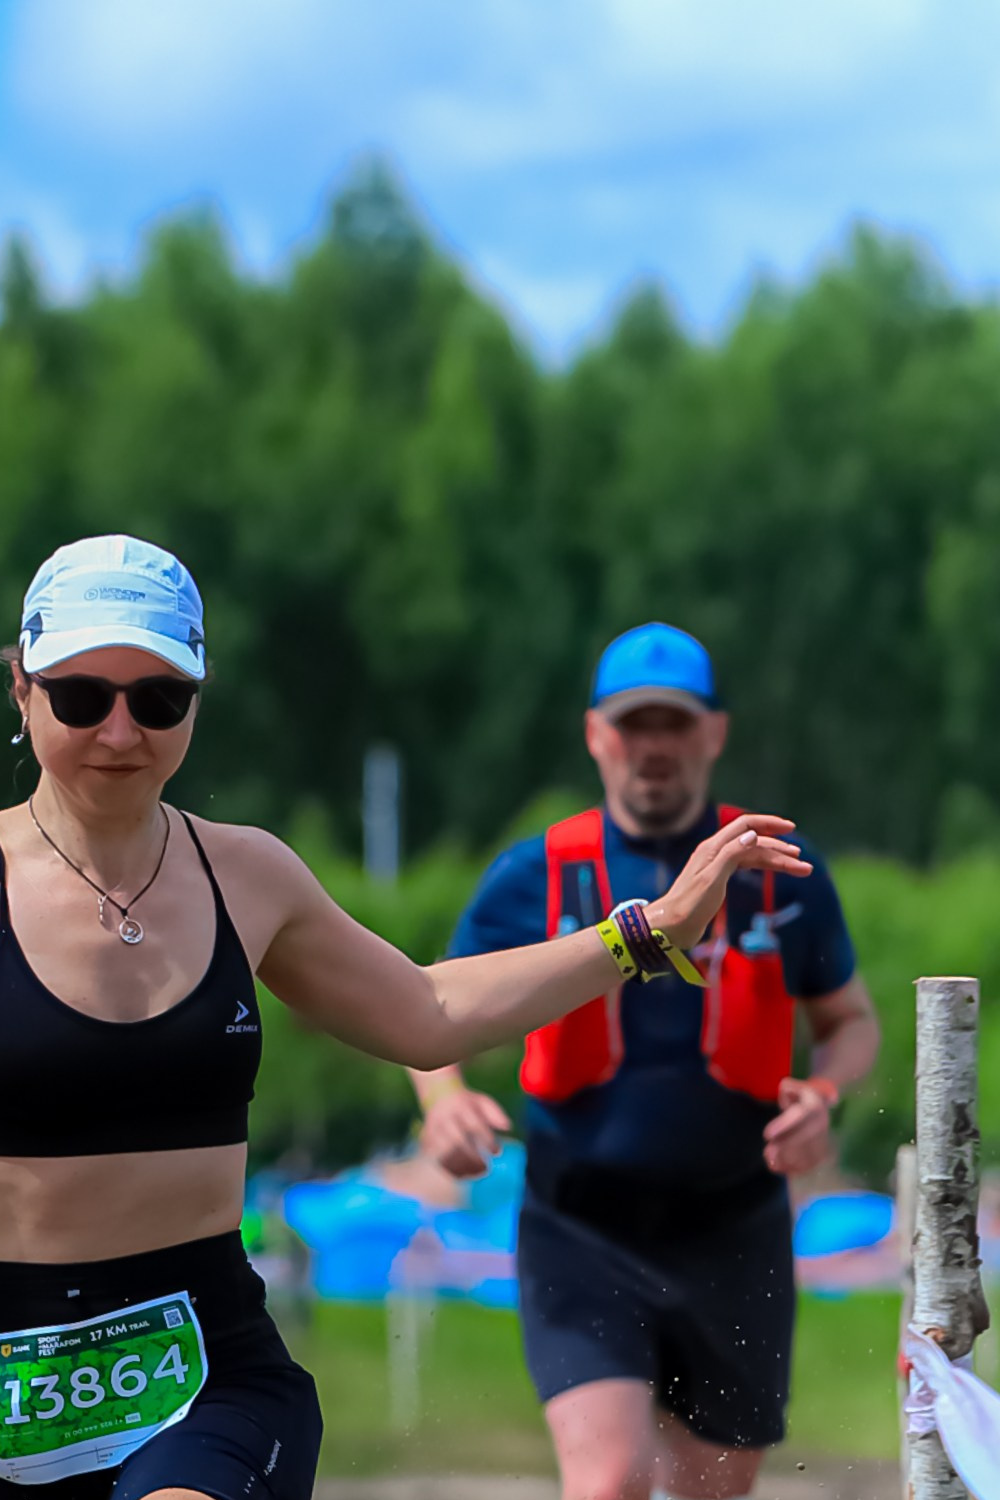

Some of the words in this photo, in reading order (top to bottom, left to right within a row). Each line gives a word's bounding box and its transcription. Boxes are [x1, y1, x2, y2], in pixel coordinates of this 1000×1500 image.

[89, 1329, 103, 1342] 17
[105, 1323, 127, 1337] KM
[128, 1320, 151, 1331] TRAIL
[37, 1335, 61, 1344] SPORT
[12, 1344, 31, 1353] BANK
[38, 1347, 56, 1357] FEST
[3, 1343, 190, 1425] 13864
